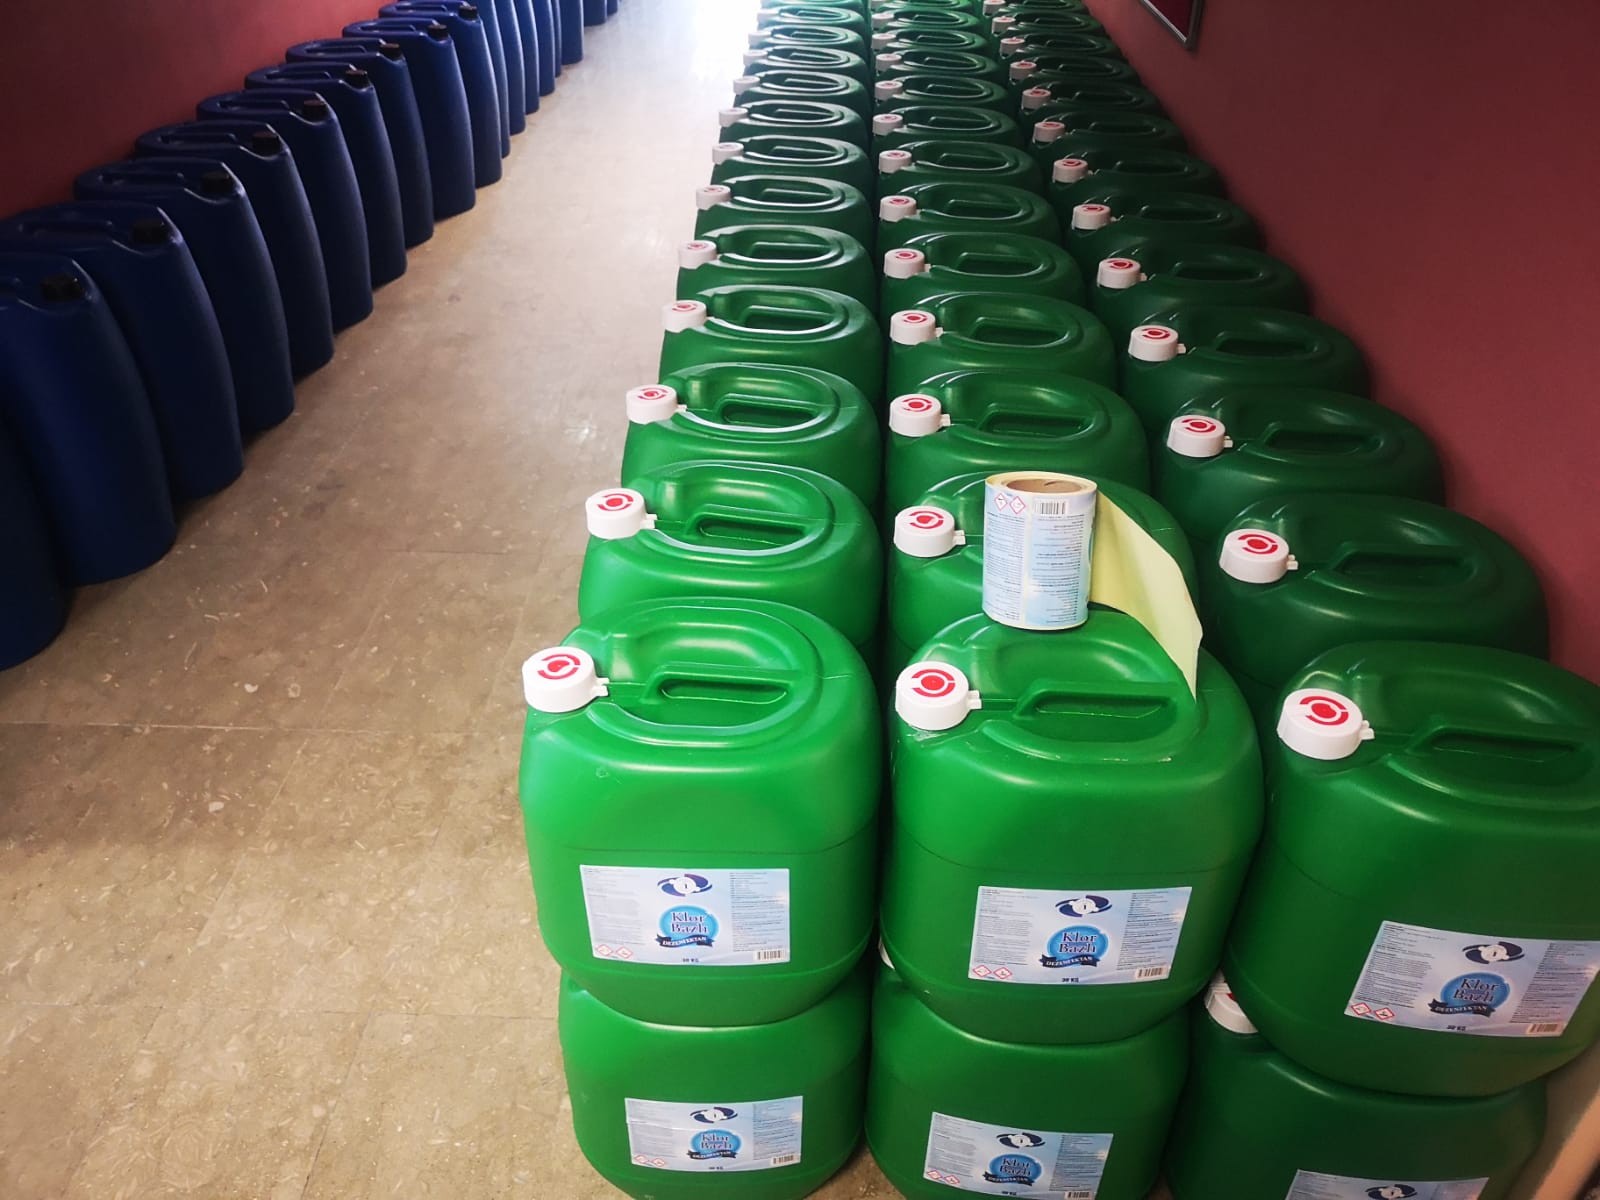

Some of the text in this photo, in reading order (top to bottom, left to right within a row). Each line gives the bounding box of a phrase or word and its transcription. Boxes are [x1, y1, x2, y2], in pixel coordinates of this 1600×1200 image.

[671, 911, 704, 922] Klor
[1063, 931, 1097, 942] Klor
[1461, 978, 1499, 991] Klor
